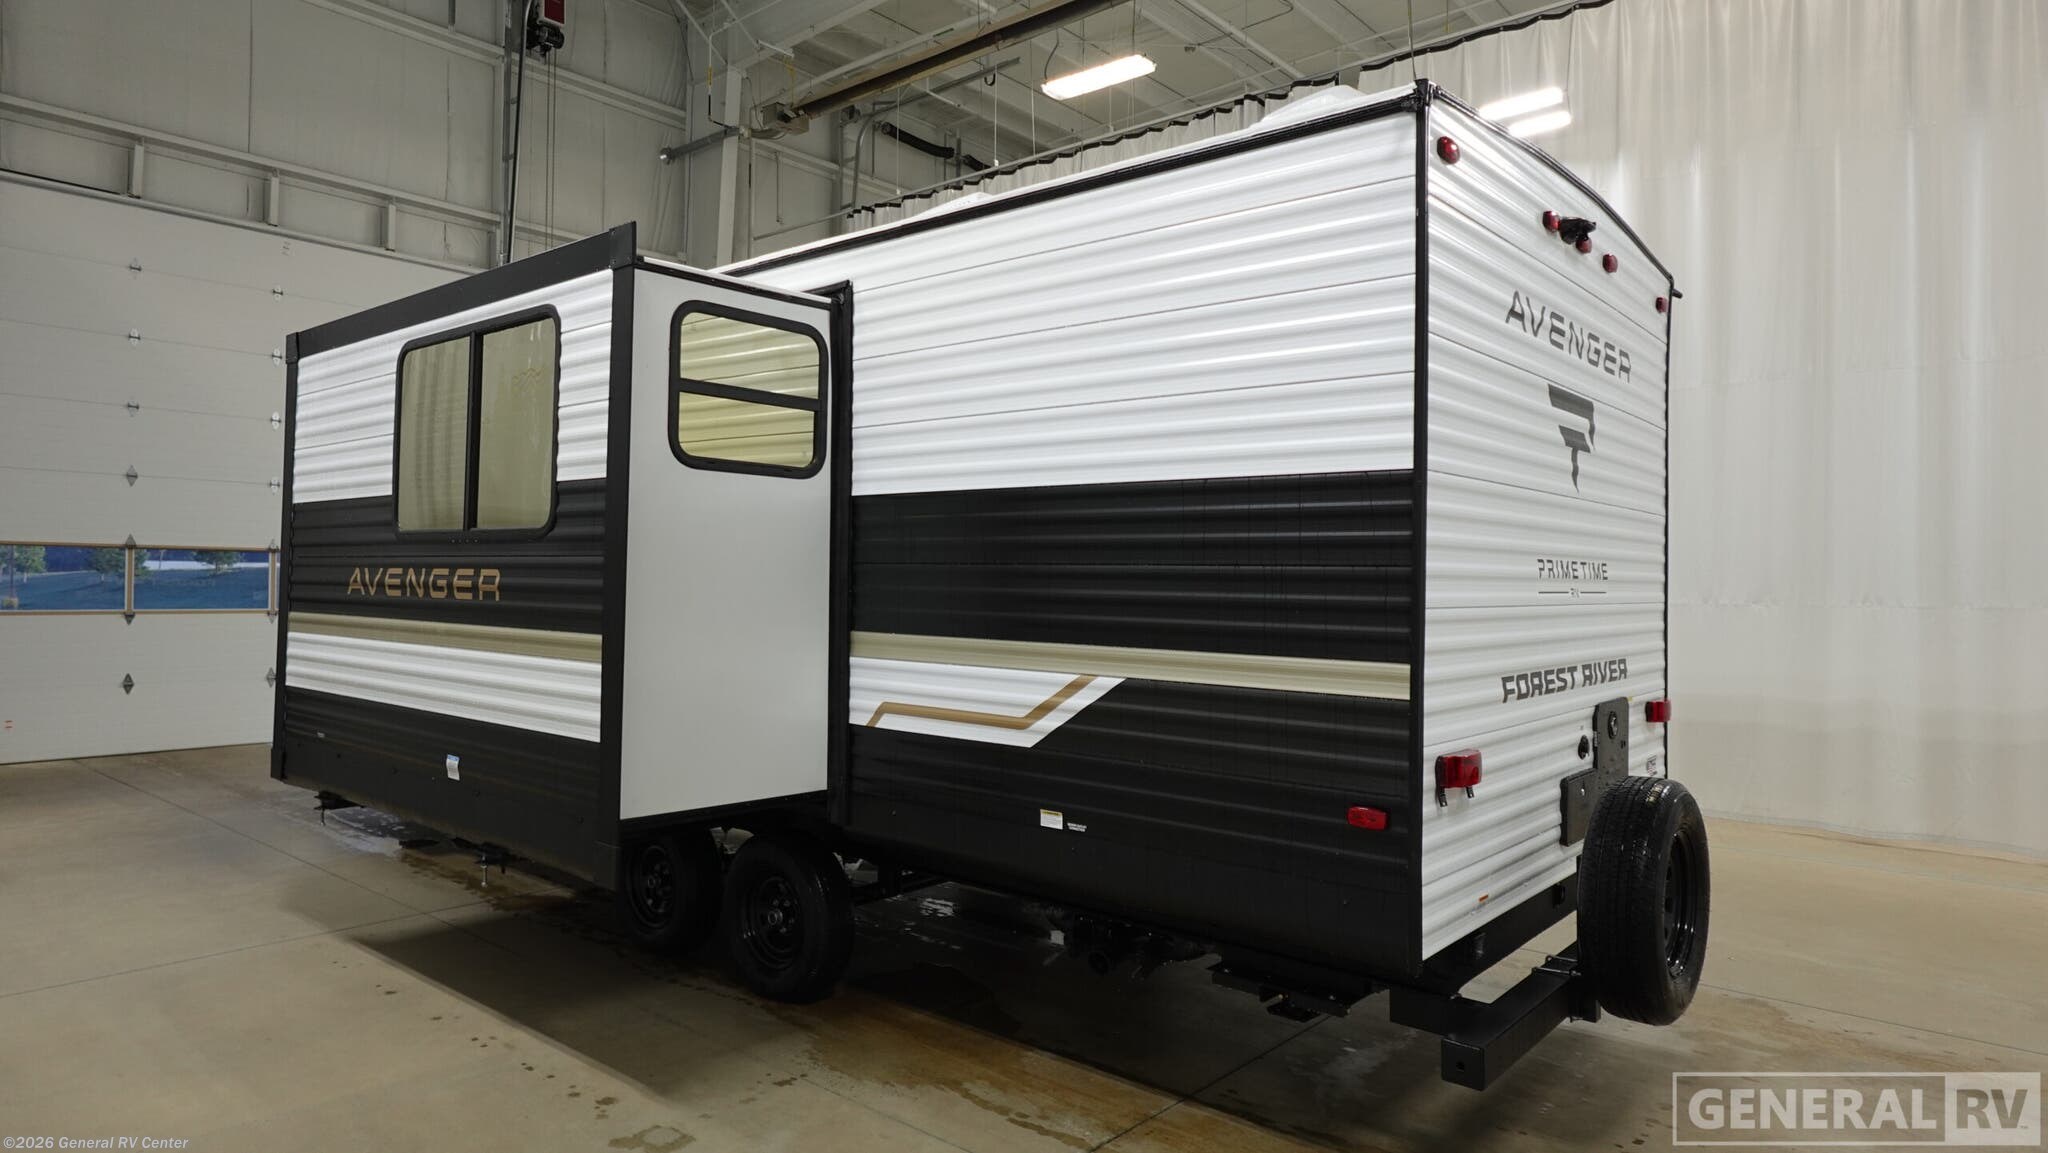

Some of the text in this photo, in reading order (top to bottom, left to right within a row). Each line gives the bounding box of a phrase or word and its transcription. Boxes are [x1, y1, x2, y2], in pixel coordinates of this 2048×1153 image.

[1505, 290, 1632, 384] AVENGER
[347, 567, 502, 602] AVENGER
[1501, 658, 1628, 703] FOREST RIVER
